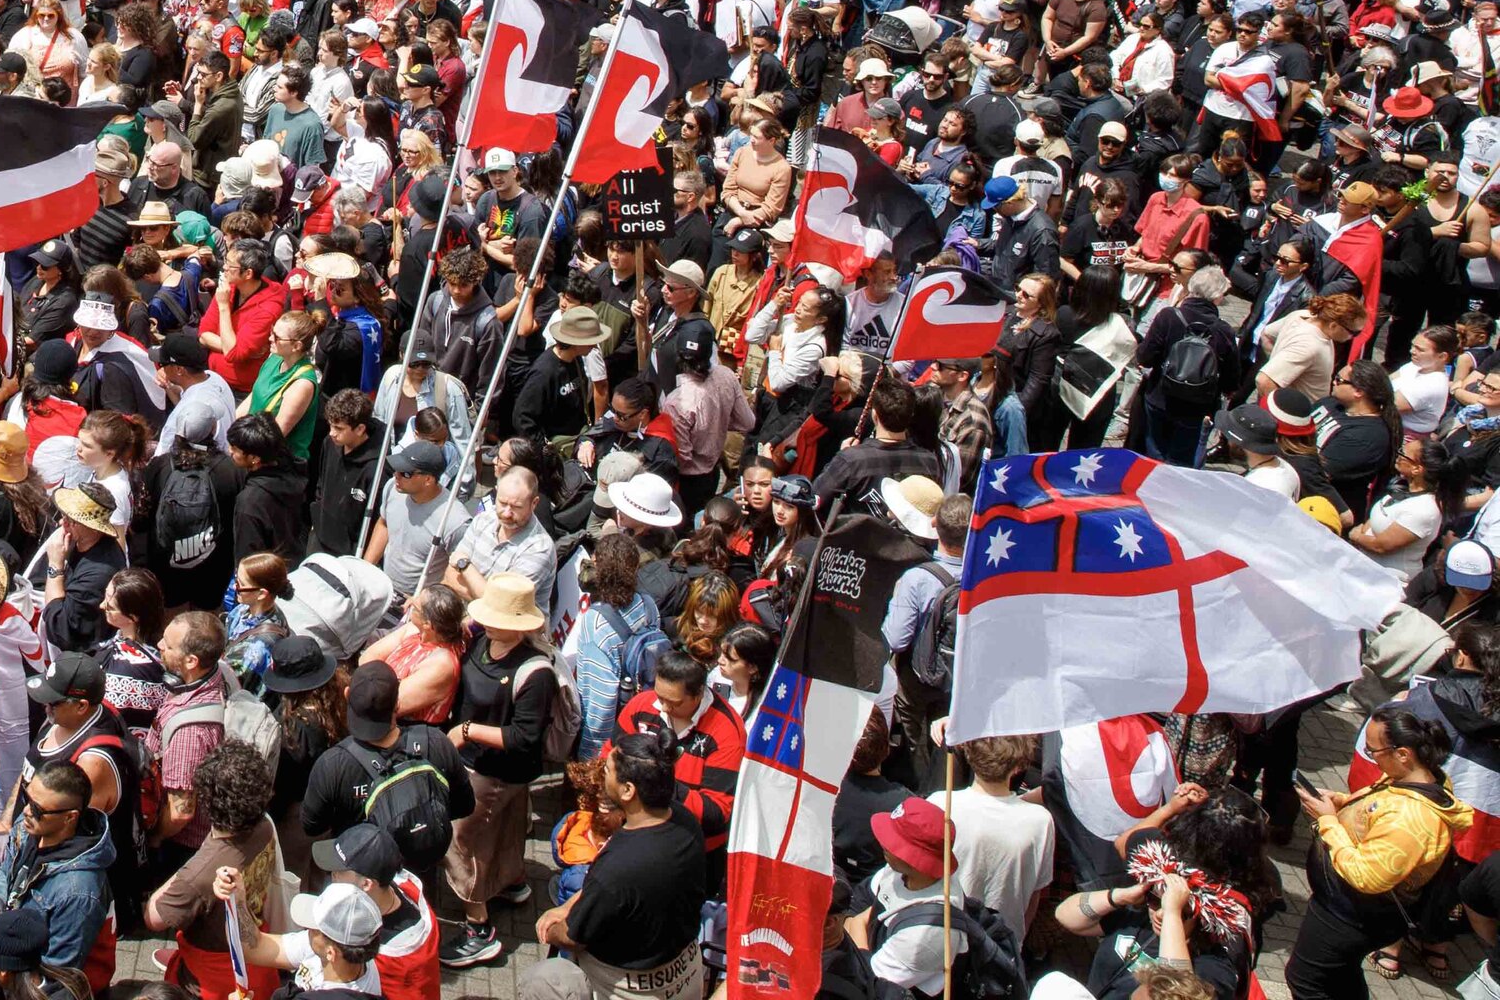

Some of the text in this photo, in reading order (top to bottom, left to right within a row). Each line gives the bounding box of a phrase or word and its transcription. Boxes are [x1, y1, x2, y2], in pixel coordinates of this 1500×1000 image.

[607, 178, 634, 195] All
[607, 199, 661, 215] Racist
[608, 218, 666, 233] Tories
[850, 335, 889, 349] adida
[174, 525, 214, 562] NIKE
[626, 953, 688, 990] LEISURE
